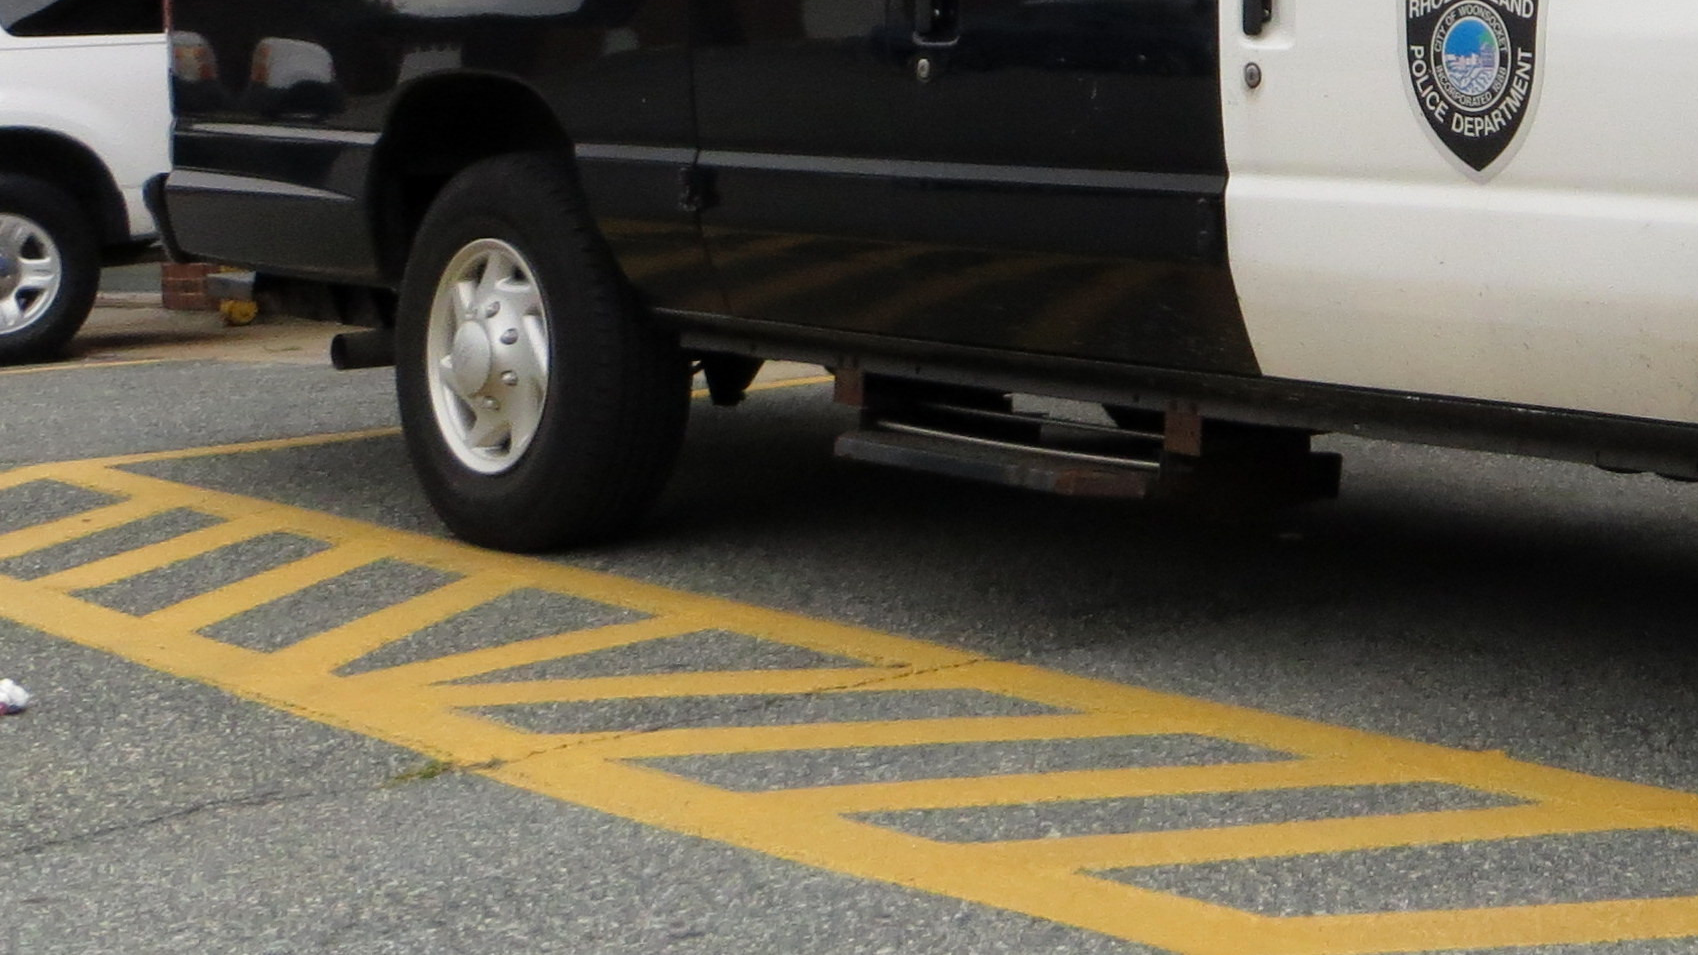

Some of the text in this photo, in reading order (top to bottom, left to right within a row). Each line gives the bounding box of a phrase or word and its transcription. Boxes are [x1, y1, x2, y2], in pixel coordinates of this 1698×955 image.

[1434, 4, 1508, 53] CITY OF WOONSOCKET
[1410, 44, 1534, 137] POLICE DEPARTMENT
[1436, 64, 1493, 107] INCORPORATED
